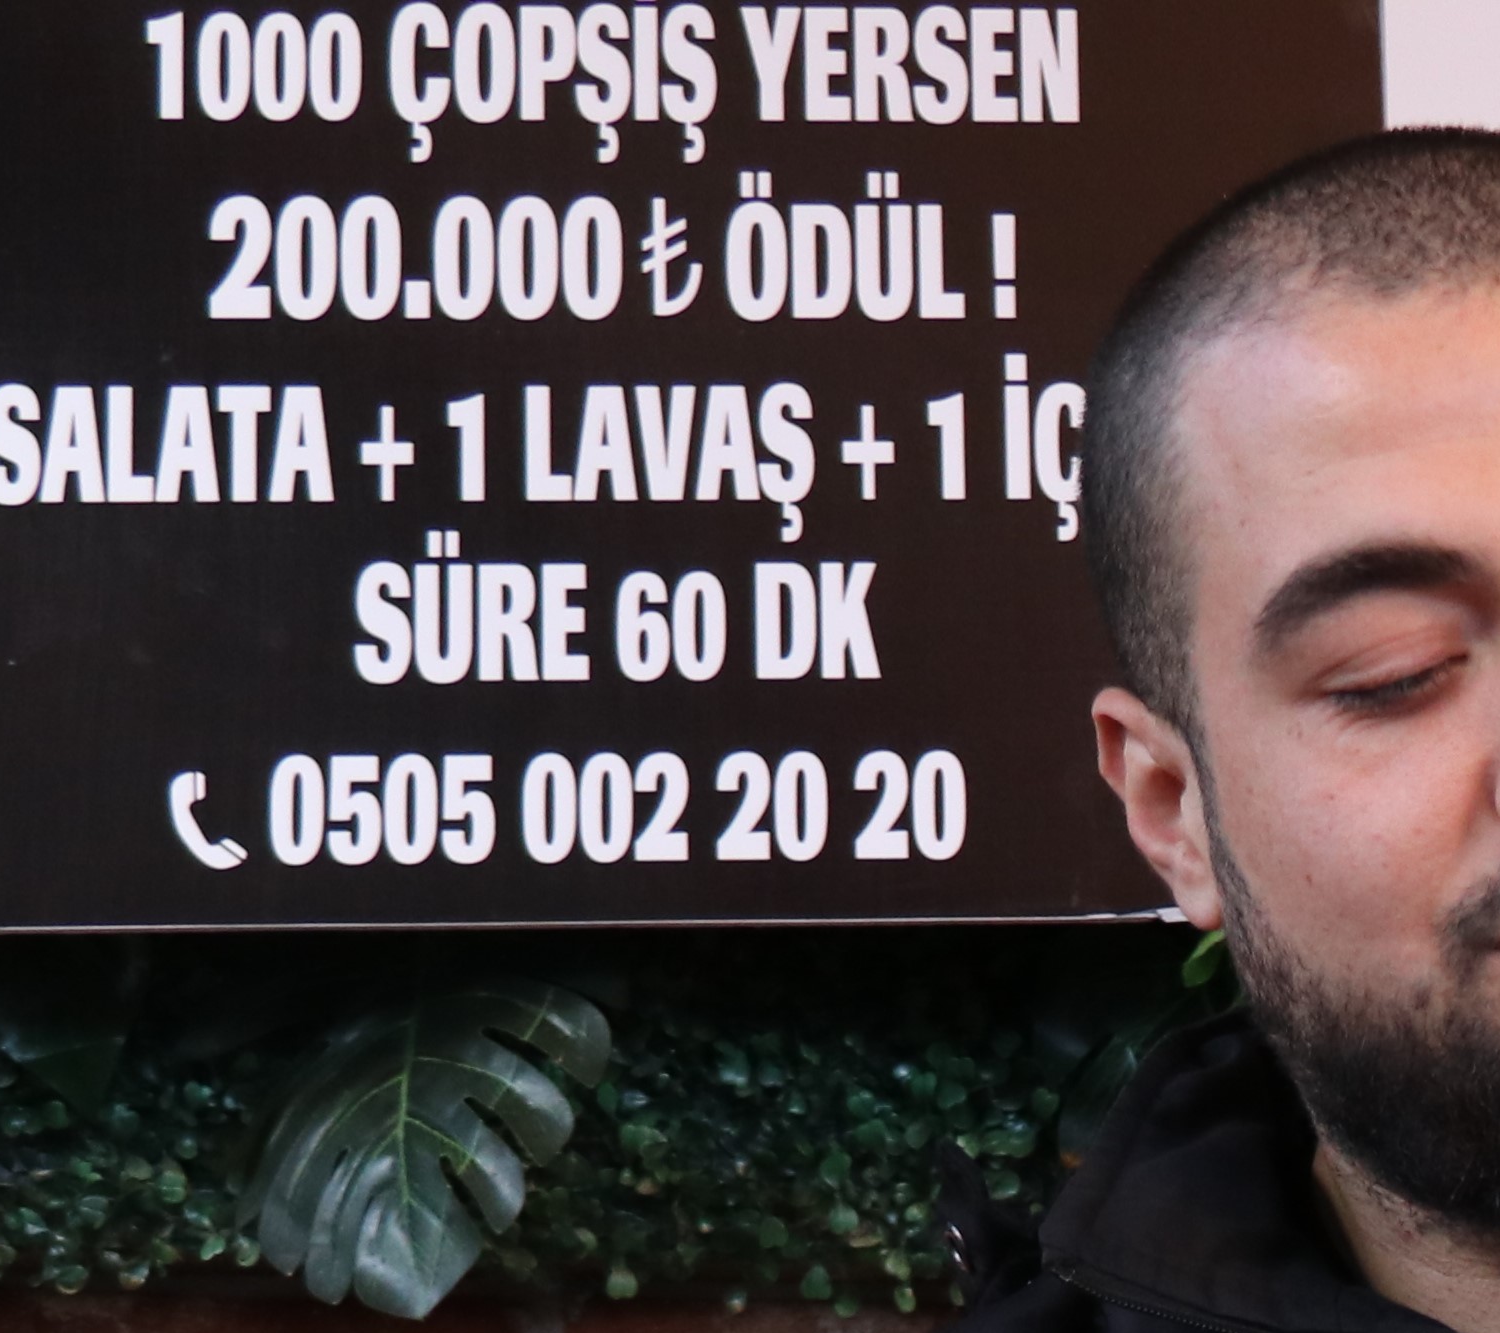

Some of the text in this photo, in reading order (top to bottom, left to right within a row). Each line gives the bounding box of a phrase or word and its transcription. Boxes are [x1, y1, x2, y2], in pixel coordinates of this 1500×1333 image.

[146, 11, 362, 121] 1000
[740, 4, 1080, 124] YERSEN
[725, 171, 966, 322] ÖDÜL
[360, 405, 415, 502] +
[447, 393, 486, 502] 1
[524, 382, 815, 543] LAVAŞ
[841, 404, 896, 501] +
[927, 392, 967, 501] 1
[1003, 352, 1087, 542] İÇ
[353, 530, 882, 685] SÜRE 60 DK
[269, 749, 967, 866] 0505 002 20 20
